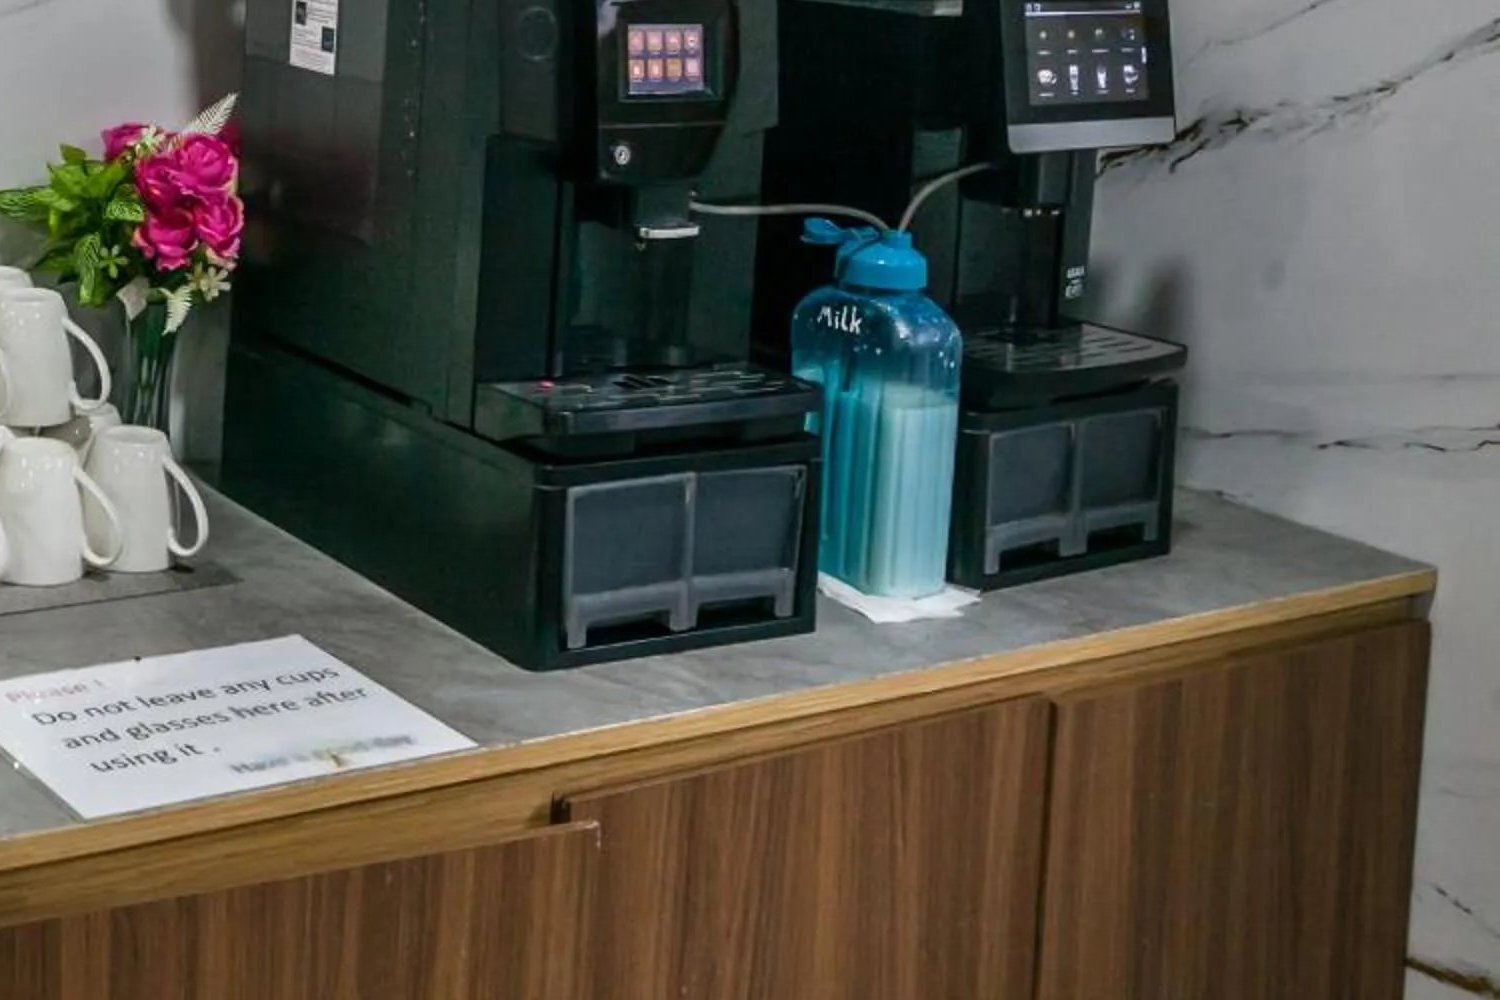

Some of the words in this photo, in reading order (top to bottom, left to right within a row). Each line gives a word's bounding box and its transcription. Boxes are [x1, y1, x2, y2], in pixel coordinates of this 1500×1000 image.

[817, 305, 862, 335] Milk
[31, 710, 77, 725] Do
[84, 700, 137, 718] not
[134, 685, 217, 708] leave
[219, 677, 271, 695] any
[275, 667, 342, 687] cups
[62, 727, 121, 749] and
[126, 710, 233, 741] glasses
[228, 699, 300, 720] here
[307, 686, 367, 708] after
[89, 749, 178, 773] using
